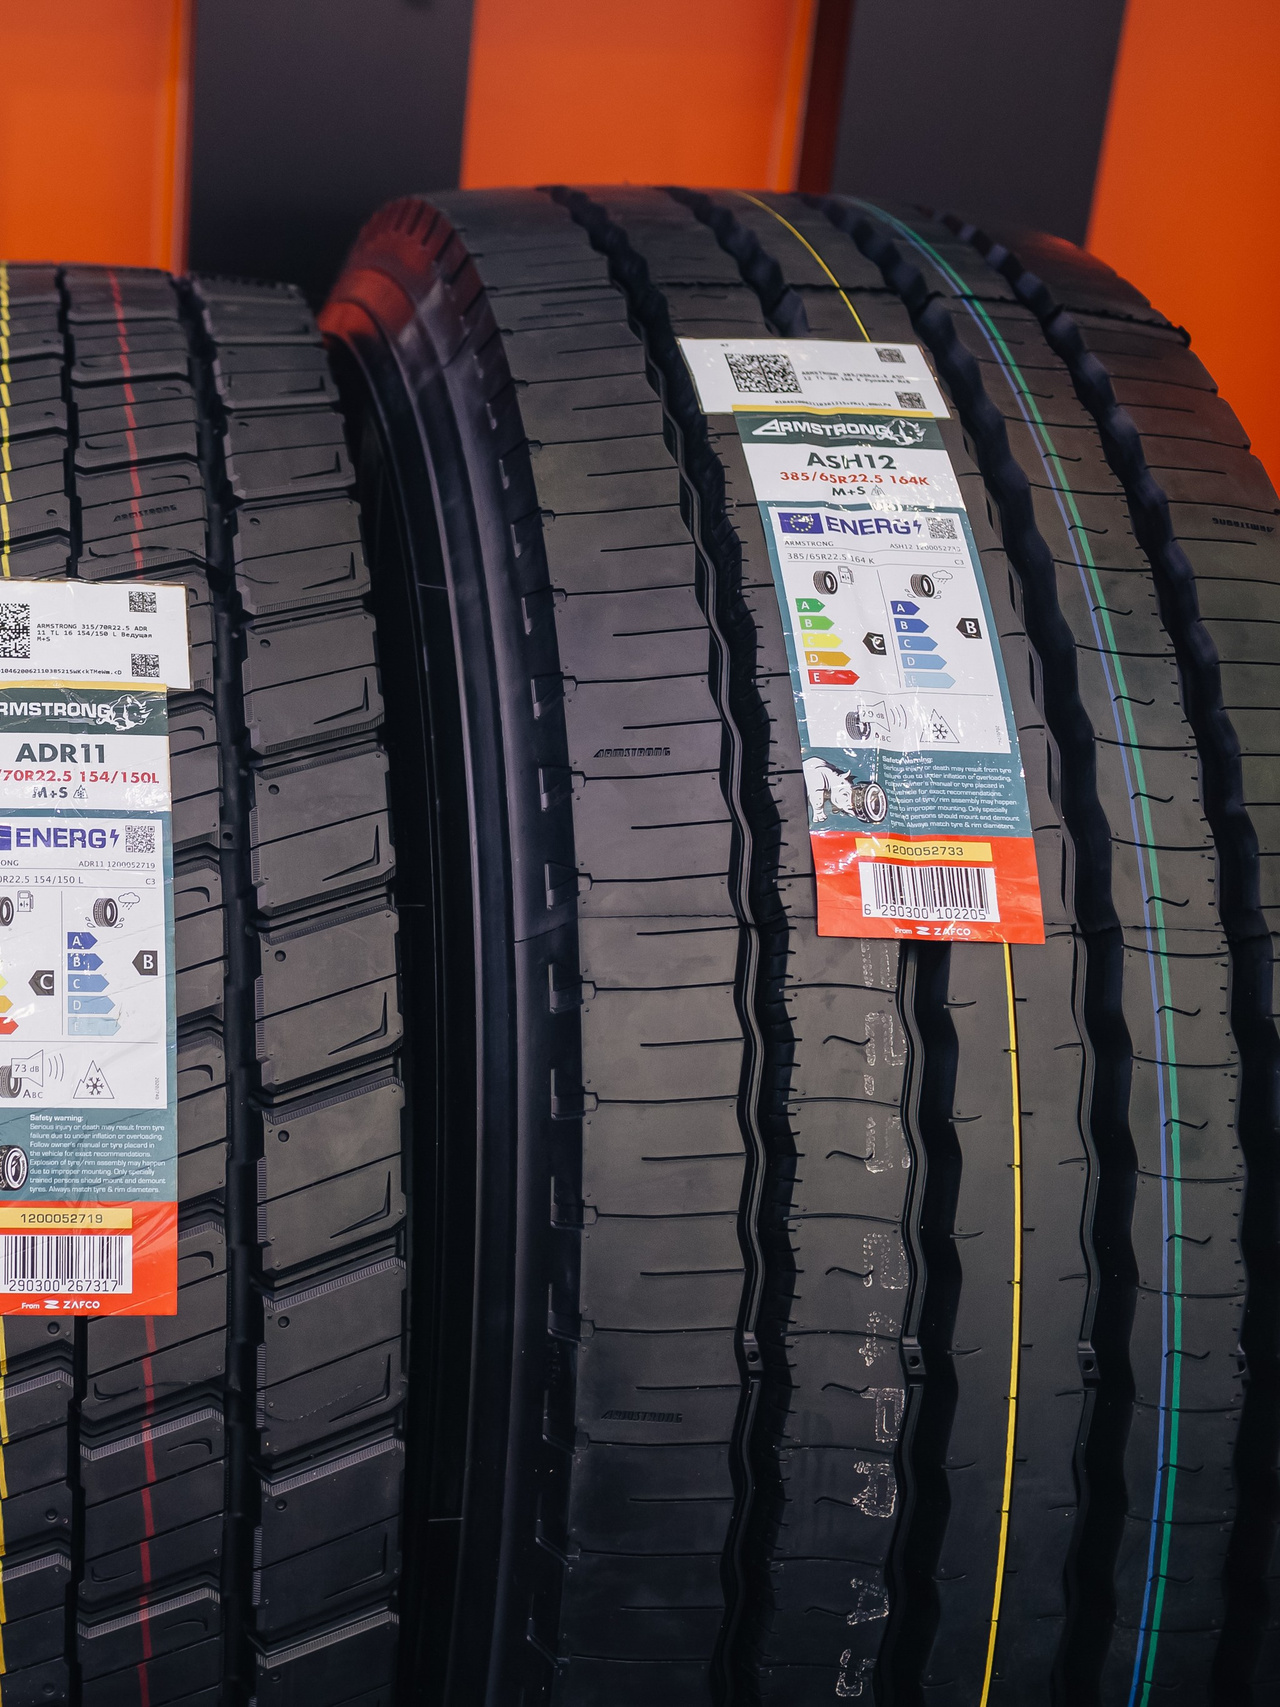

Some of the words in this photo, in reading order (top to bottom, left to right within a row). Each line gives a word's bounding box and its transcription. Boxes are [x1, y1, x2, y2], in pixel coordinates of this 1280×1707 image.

[752, 419, 891, 437] ARMSTRONG
[807, 452, 896, 470] ASH12
[780, 472, 883, 484] 385/65R22.5
[890, 475, 929, 486] 164K
[832, 486, 866, 496] M+S
[851, 555, 866, 563] 164
[897, 604, 905, 612] A
[900, 621, 908, 629] B
[965, 621, 977, 634] B
[904, 639, 911, 648] C
[810, 655, 818, 663] D
[907, 657, 915, 666] D
[813, 673, 820, 682] E
[15, 744, 105, 763] ADR11
[594, 747, 670, 758] ARMSTRONG
[80, 771, 159, 784] 154/150L
[32, 786, 68, 798] M+S
[16, 828, 106, 848] ENERG
[886, 844, 963, 856] 1200052733
[34, 876, 75, 884] 154/150
[864, 904, 871, 915] 6
[882, 906, 929, 919] 290300
[936, 908, 986, 920] 102205
[934, 927, 971, 935] ZAFCO
[73, 936, 82, 945] A
[74, 957, 80, 966] B
[143, 955, 153, 969] B
[40, 975, 53, 989] C
[73, 979, 80, 988] C
[74, 1001, 81, 1010] D
[15, 1064, 27, 1072] 73
[23, 1090, 43, 1098] ABC
[30, 1114, 52, 1122] Safety
[126, 1133, 163, 1141] overloading.
[68, 1159, 95, 1167] tyre/rim
[51, 1168, 80, 1176] improper
[114, 1168, 127, 1176] Only
[129, 1168, 154, 1176] specially
[20, 1214, 103, 1224] 1200052719
[9, 1280, 60, 1292] 290300
[67, 1280, 118, 1292] 267317
[63, 1301, 100, 1309] ZAFCO
